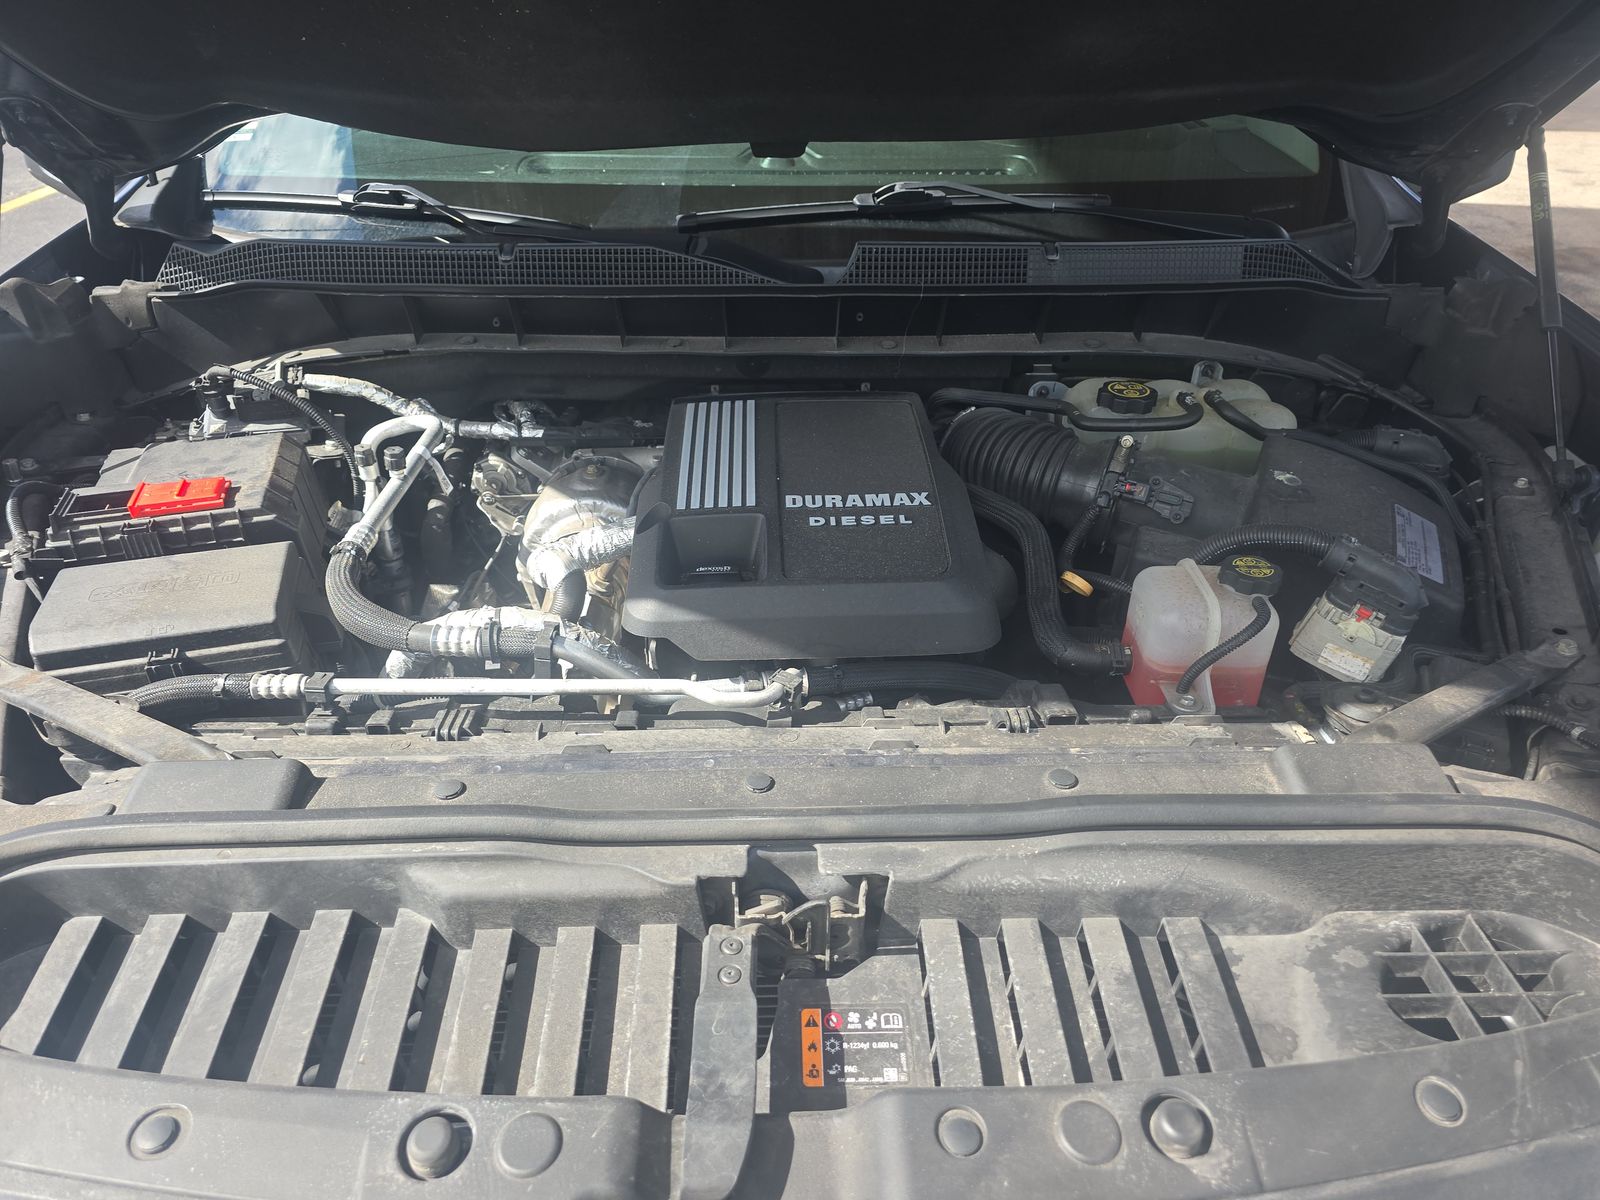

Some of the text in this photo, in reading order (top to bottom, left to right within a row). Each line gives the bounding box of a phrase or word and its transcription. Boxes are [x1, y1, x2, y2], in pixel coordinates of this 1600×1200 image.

[785, 492, 932, 508] DURAMAX
[808, 514, 913, 527] DIESEL
[844, 1065, 858, 1073] PAG
